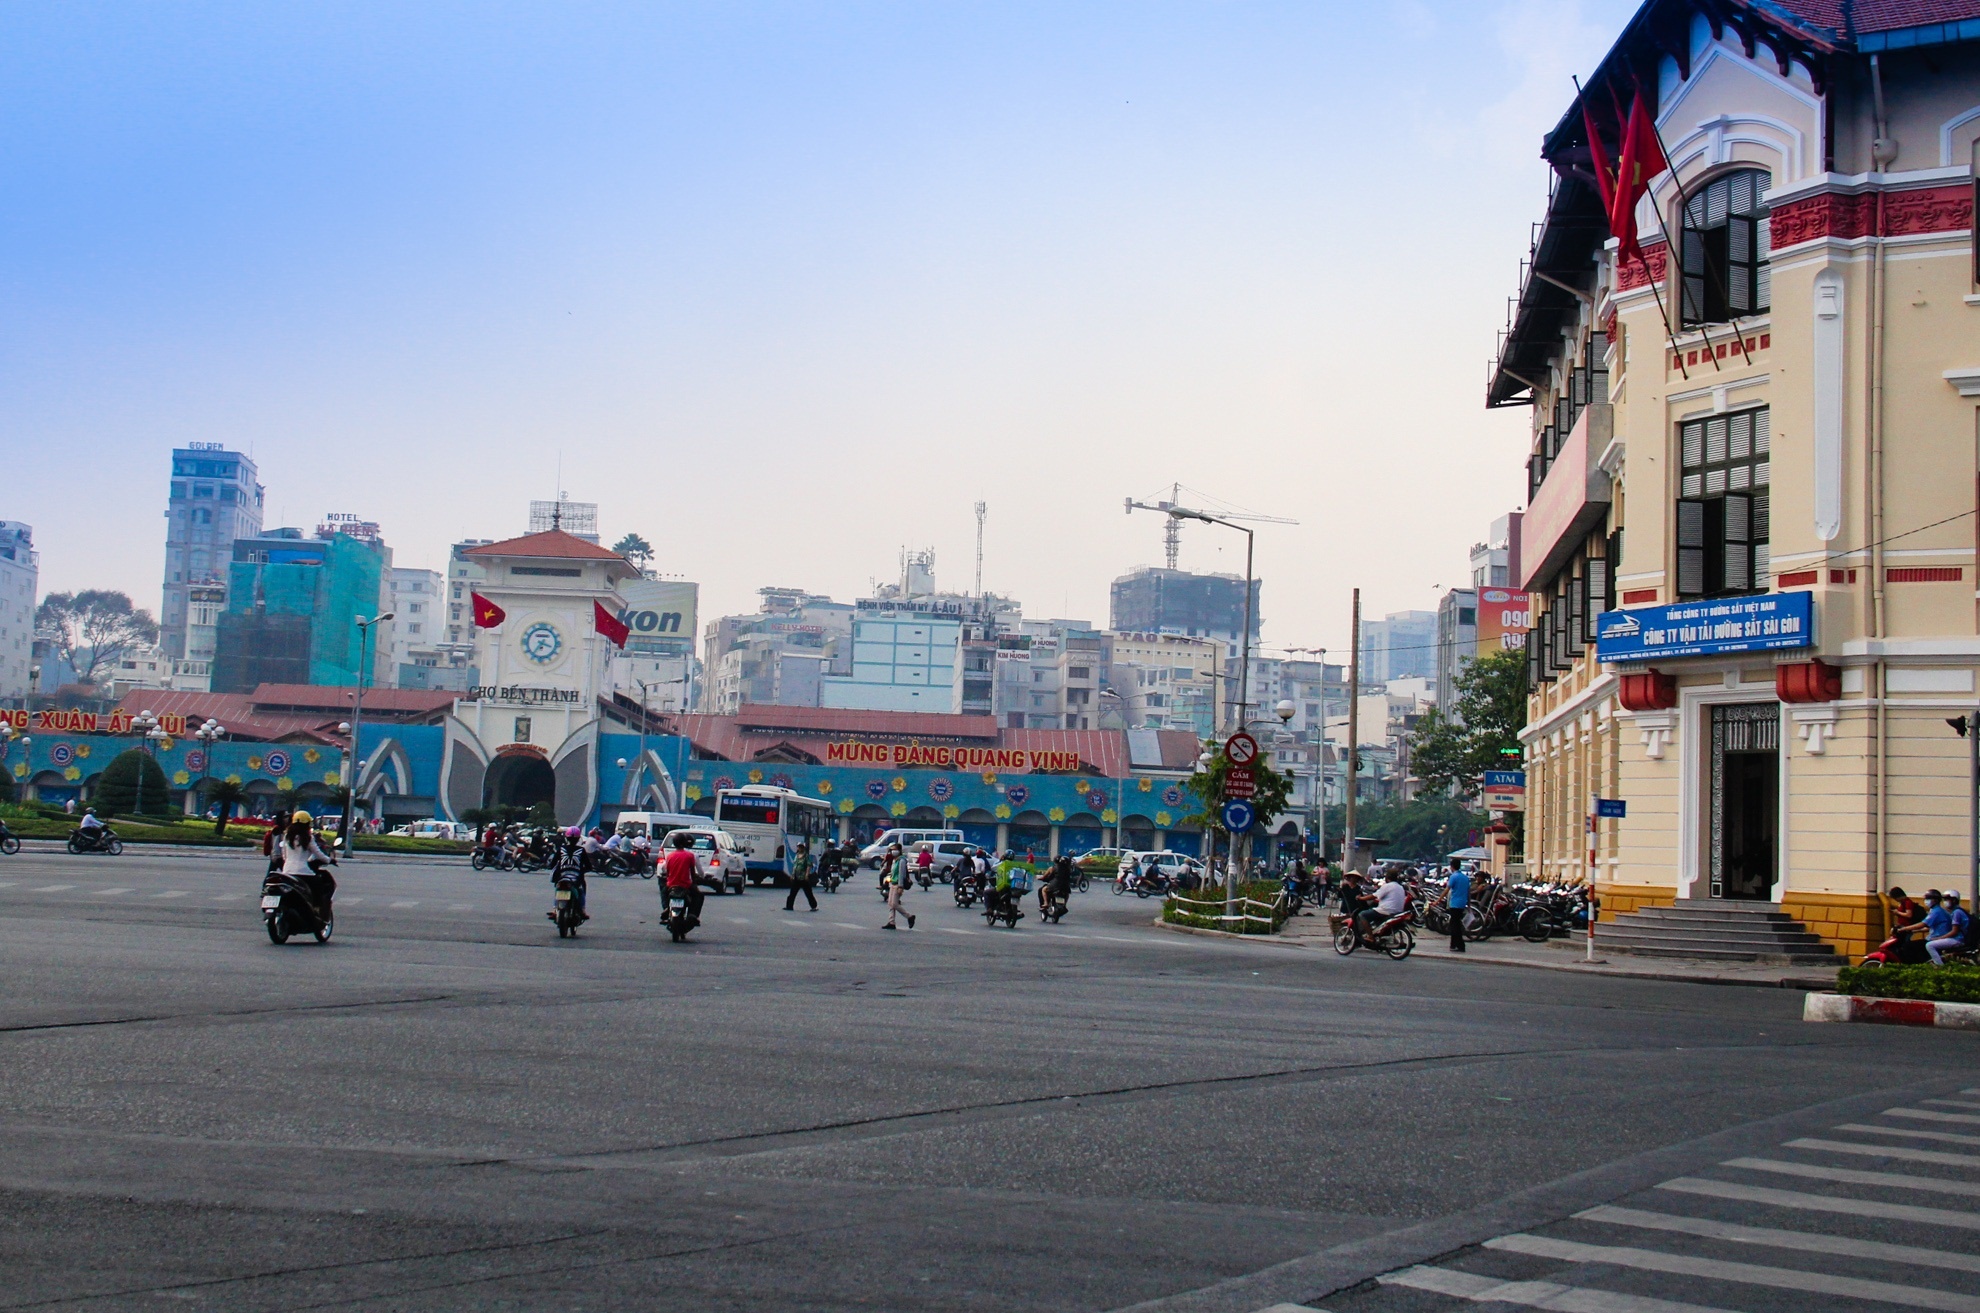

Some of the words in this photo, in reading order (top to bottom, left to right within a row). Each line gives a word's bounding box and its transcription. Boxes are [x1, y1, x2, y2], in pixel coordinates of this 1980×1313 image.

[327, 513, 358, 521] HOTEL
[857, 600, 878, 610] BỆNH
[879, 601, 895, 611] VIỆN
[1666, 607, 1682, 620] TỔNG
[1683, 608, 1699, 618] CÔNG
[1700, 608, 1708, 617] TY
[1731, 602, 1743, 614] SẮT
[1745, 602, 1759, 613] VIỆT
[1760, 601, 1776, 612] NAM
[1644, 628, 1666, 646] CÔNG
[1667, 628, 1677, 644] TY
[1680, 624, 1696, 645] VẬN
[1698, 620, 1712, 640] TẢI
[1714, 619, 1742, 640] ĐƯỜNG
[1744, 614, 1762, 636] SẮT
[1764, 616, 1778, 635] SÀI
[1780, 614, 1800, 634] GÒN
[469, 686, 496, 700] CHỢ
[501, 684, 527, 699] BẾN
[532, 687, 580, 702] THÀNH
[40, 708, 98, 732] XUÂN
[108, 708, 136, 733] ẤT
[827, 740, 888, 762] MỪNG
[893, 740, 950, 766] ĐẢNG
[954, 748, 1025, 769] QUANG
[1028, 750, 1080, 771] VINH
[1232, 770, 1248, 779] CẤM
[1493, 774, 1516, 784] ATM
